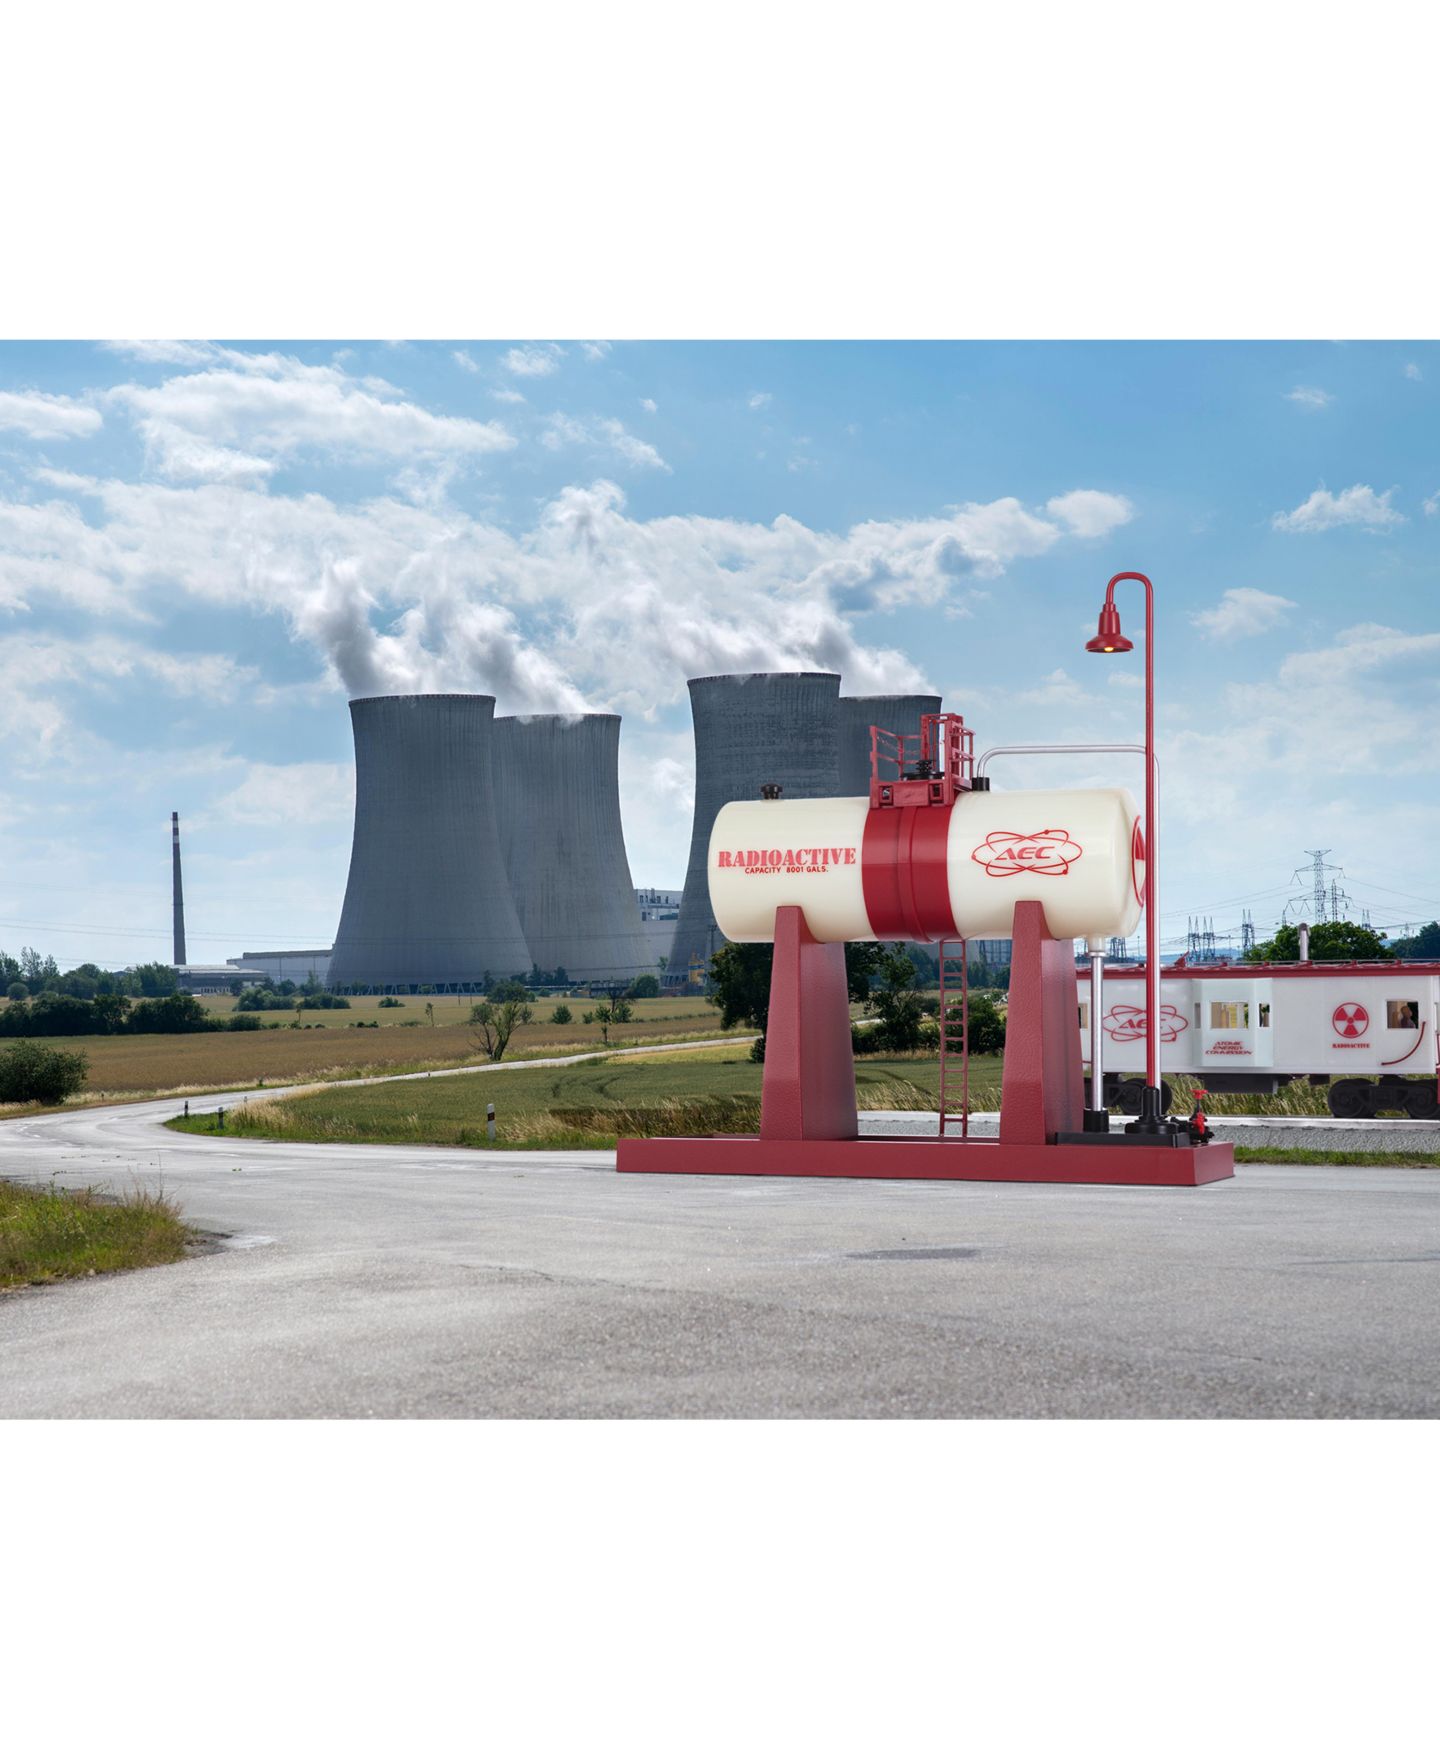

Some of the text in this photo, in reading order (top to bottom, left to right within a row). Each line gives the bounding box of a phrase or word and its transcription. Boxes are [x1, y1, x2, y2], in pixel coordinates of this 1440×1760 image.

[718, 848, 856, 867] RADIOACTIVE
[994, 846, 1056, 861] AEC
[744, 866, 782, 874] CAPACITY
[806, 865, 829, 873] GALS.
